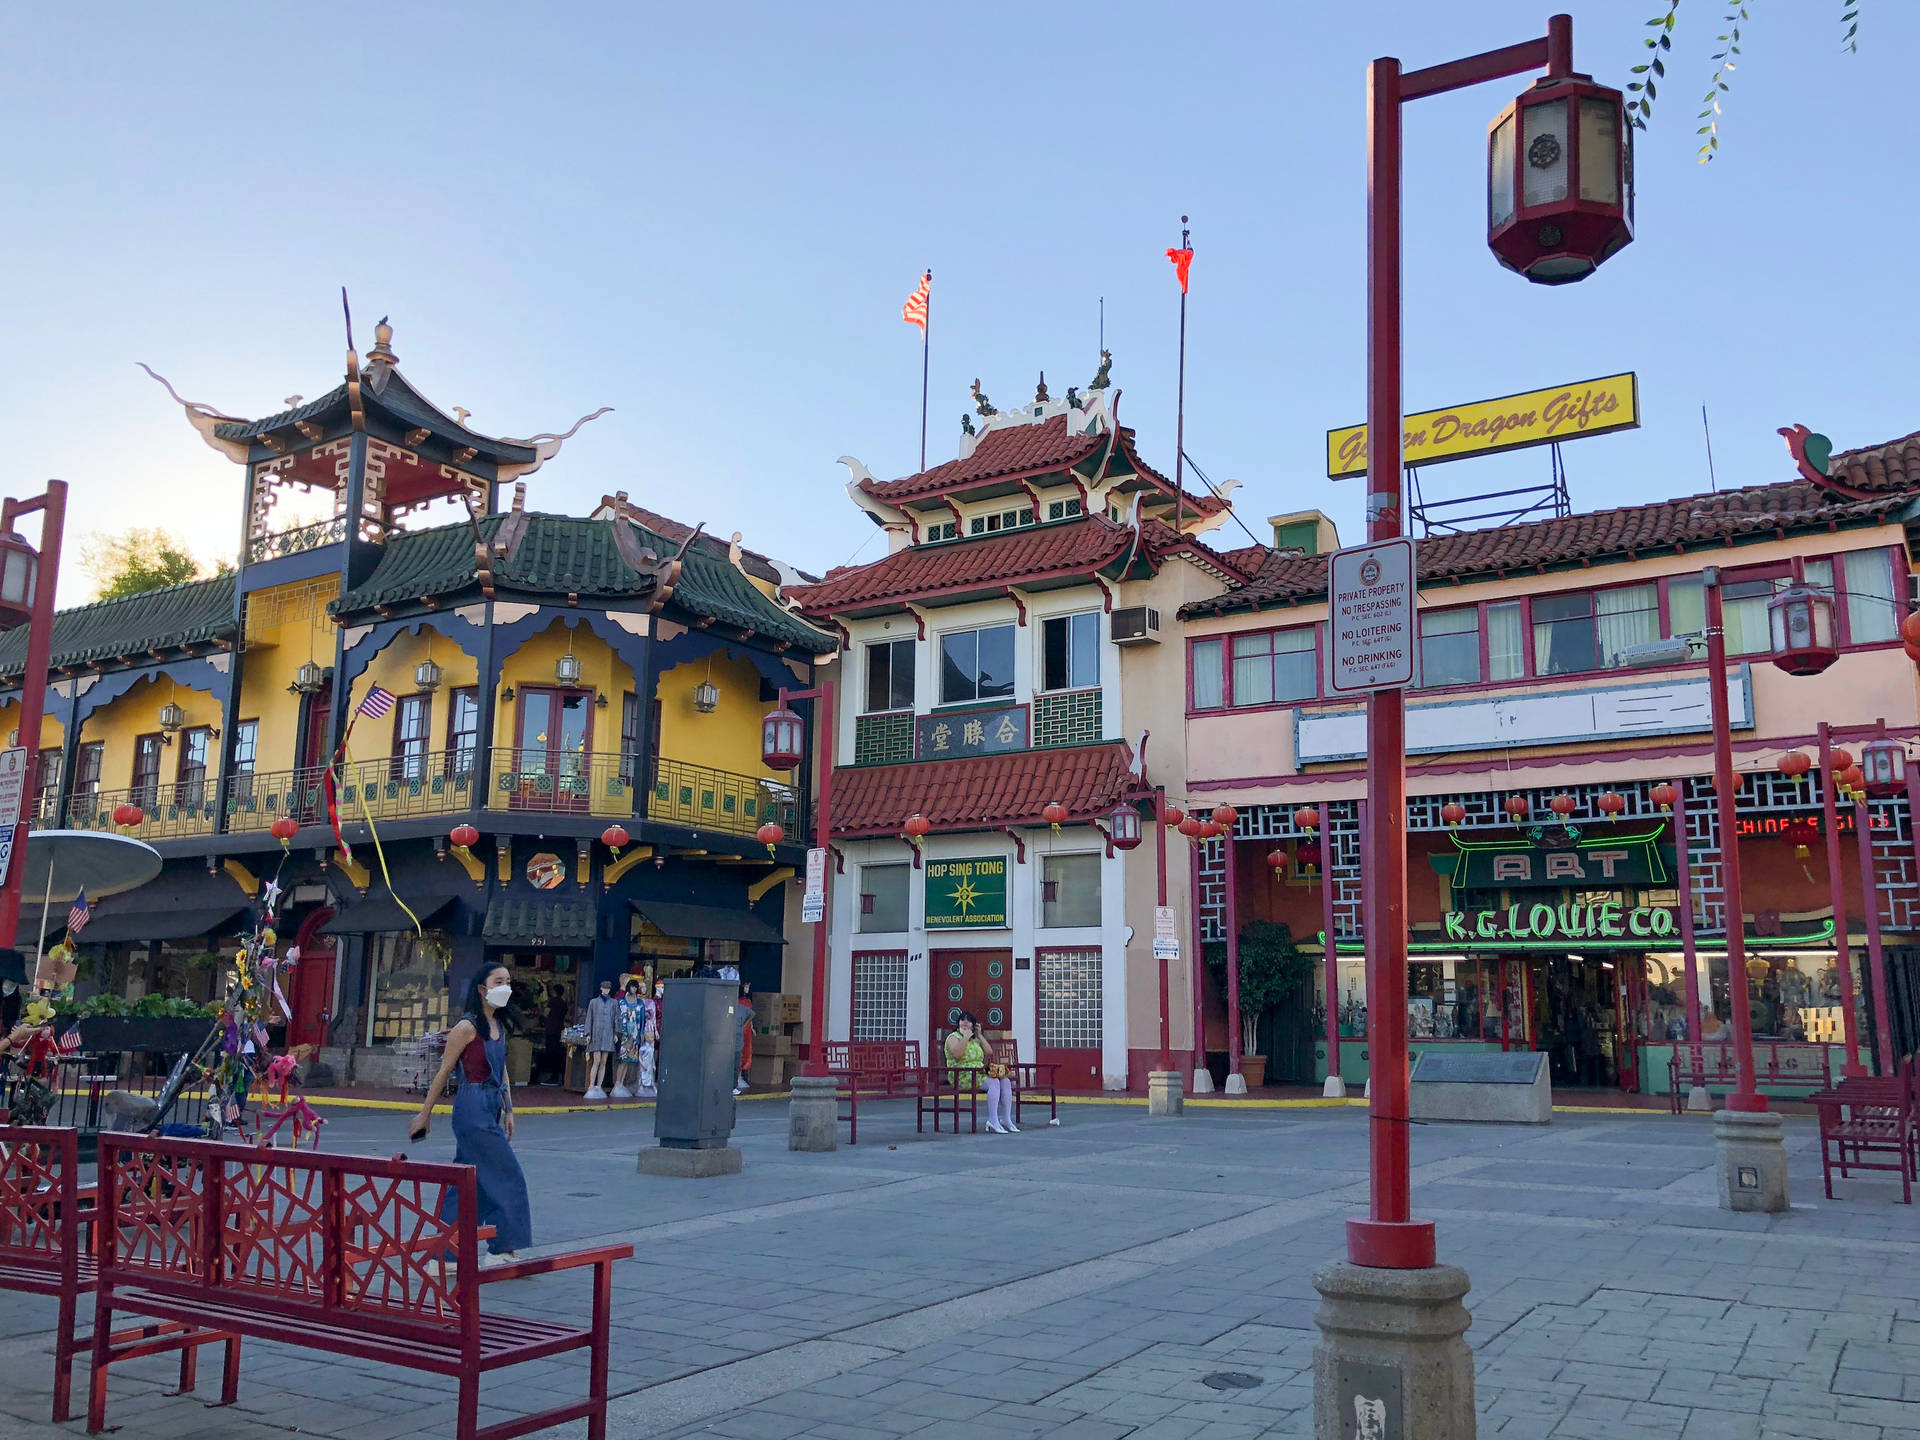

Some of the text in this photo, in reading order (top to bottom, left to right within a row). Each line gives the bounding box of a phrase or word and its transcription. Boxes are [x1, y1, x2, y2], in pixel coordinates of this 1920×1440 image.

[1338, 389, 1620, 471] Goen Dragon Gifts
[1338, 582, 1405, 603] PRIVATE PROPERTY
[1341, 597, 1402, 616] NO TRESPASSING
[1341, 622, 1402, 640] NO LOITERING
[1342, 649, 1402, 666] NO DRINKING
[927, 861, 1004, 878] HOP SING TONG
[1493, 850, 1629, 881] ART
[926, 913, 1004, 924] BENEVOLENT ASSOCIATION
[1445, 901, 1681, 940] K.G. LOUIE CO.
[531, 937, 546, 946] 951
